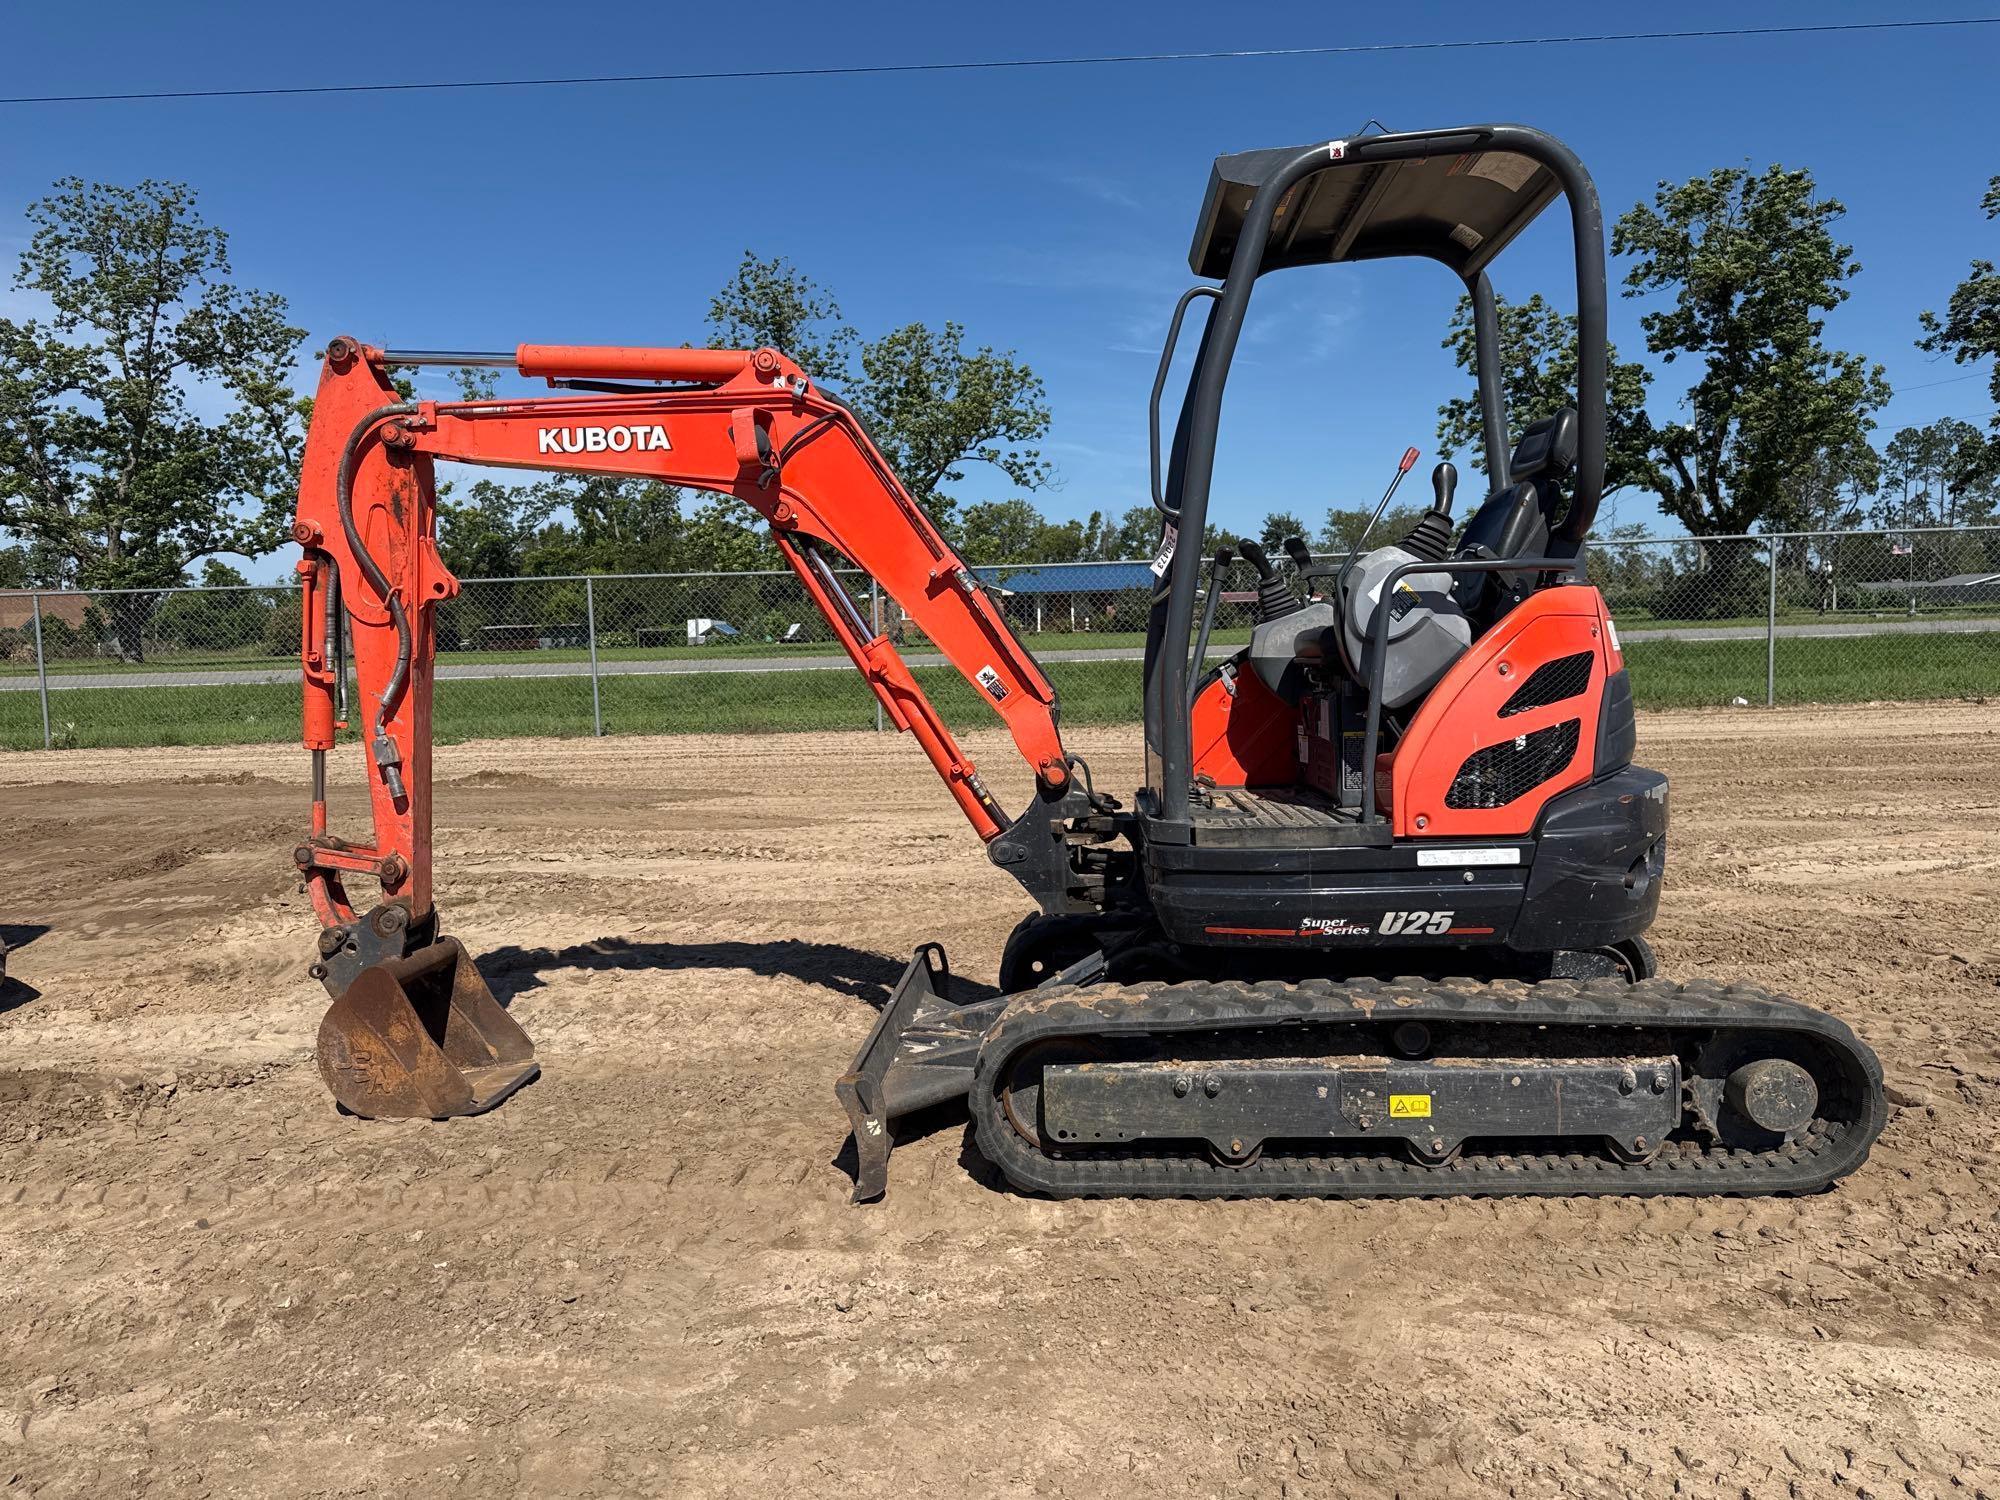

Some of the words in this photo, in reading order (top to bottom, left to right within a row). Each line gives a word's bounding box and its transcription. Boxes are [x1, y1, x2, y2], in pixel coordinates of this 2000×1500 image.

[538, 425, 672, 454] KUBOTA
[1301, 918, 1347, 930] Super
[1323, 925, 1370, 936] Series
[1378, 911, 1455, 935] U25
